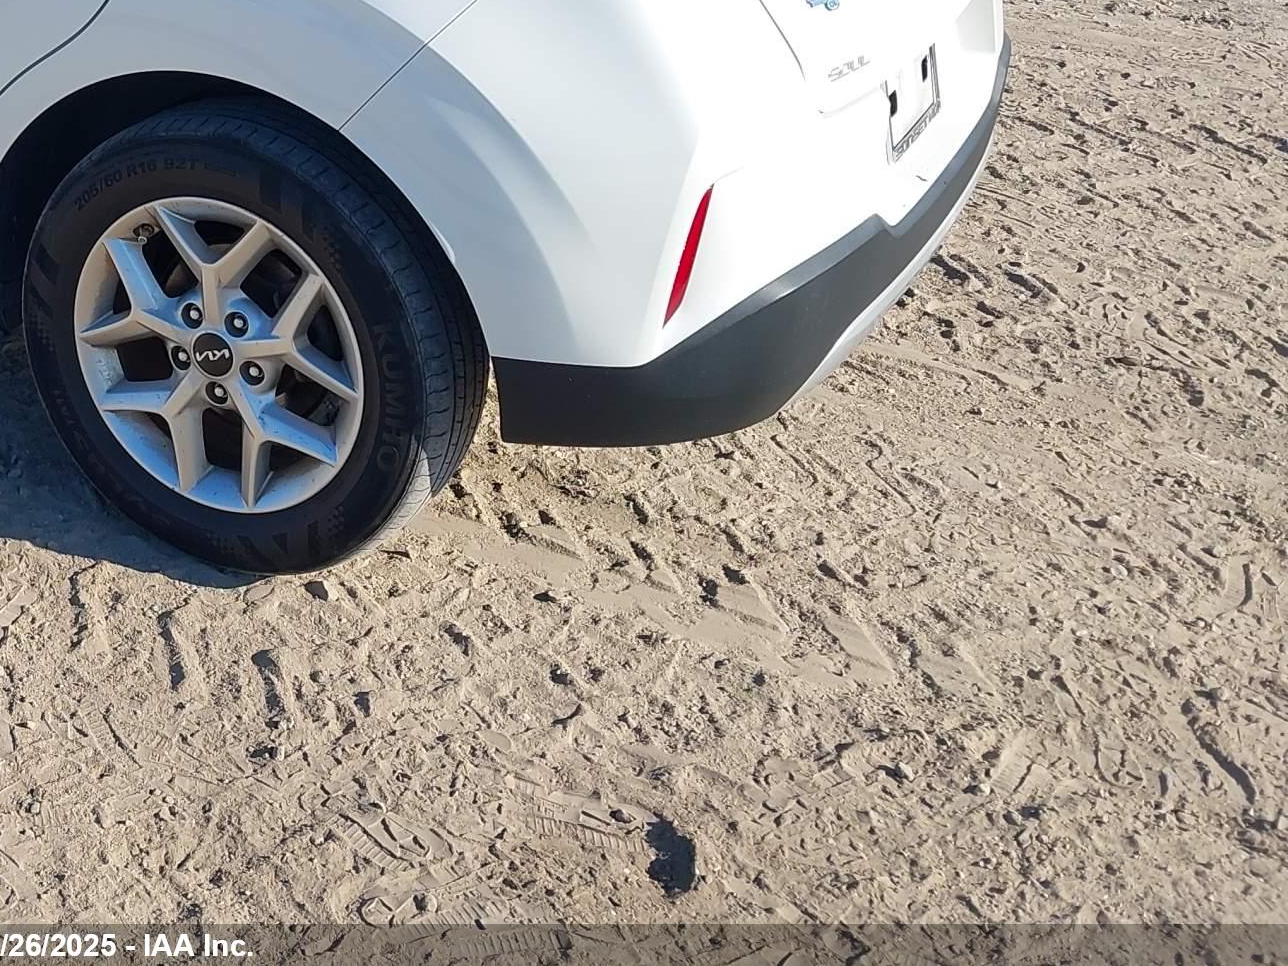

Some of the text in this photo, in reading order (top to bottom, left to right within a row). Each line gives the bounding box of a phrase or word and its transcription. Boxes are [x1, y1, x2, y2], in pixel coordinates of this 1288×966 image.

[828, 55, 871, 82] SOUL
[74, 170, 123, 210] 205/60
[126, 161, 157, 178] R16
[195, 349, 230, 362] KIA
